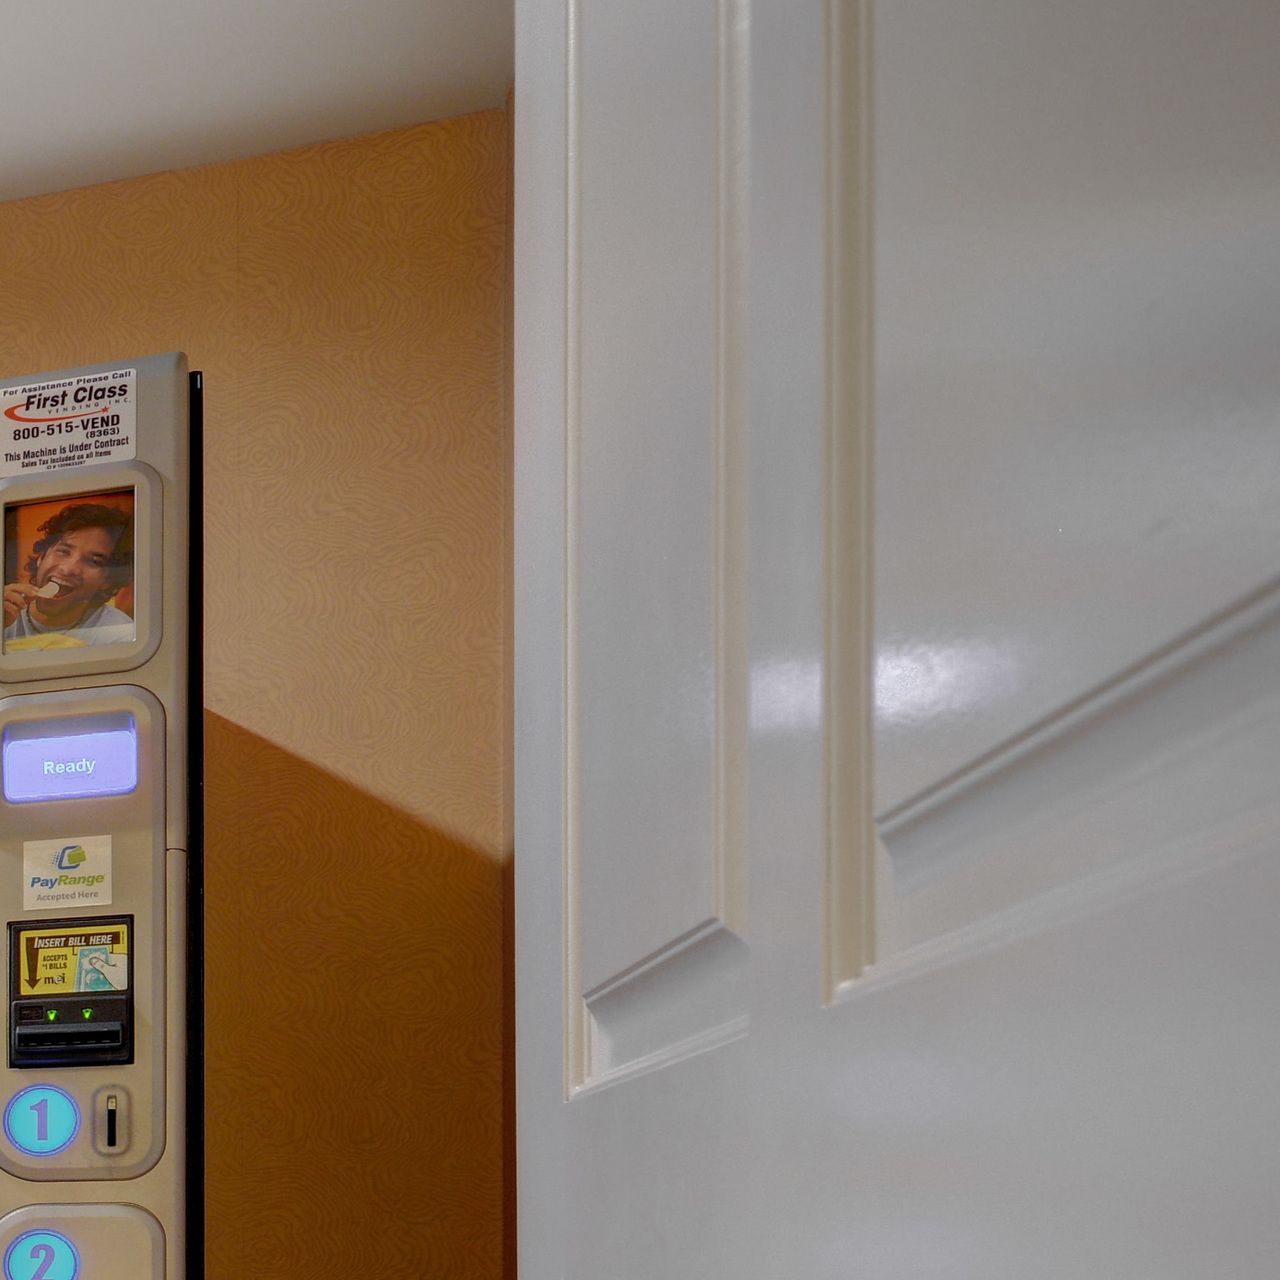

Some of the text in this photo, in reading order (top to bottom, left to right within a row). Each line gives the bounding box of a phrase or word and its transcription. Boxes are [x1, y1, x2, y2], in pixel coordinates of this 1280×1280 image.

[21, 381, 74, 394] Assistance
[76, 375, 109, 385] Please
[112, 370, 131, 380] Call
[24, 384, 129, 411] First Class
[48, 402, 100, 414] VENDING
[13, 414, 120, 441] 800-515-VEND
[86, 427, 120, 439] (8363)
[5, 436, 129, 462] This Machine is Under Contract
[21, 460, 37, 468] Sales
[39, 458, 49, 466] Tax
[43, 758, 96, 777] Ready
[30, 873, 105, 889] PayRange
[36, 890, 99, 902] Accepted Here
[34, 934, 113, 949] INSERT BILL HERE
[43, 954, 68, 962] ACCEPTS
[48, 962, 68, 970] BILLS
[44, 973, 66, 985] mei
[30, 1098, 49, 1141] 1
